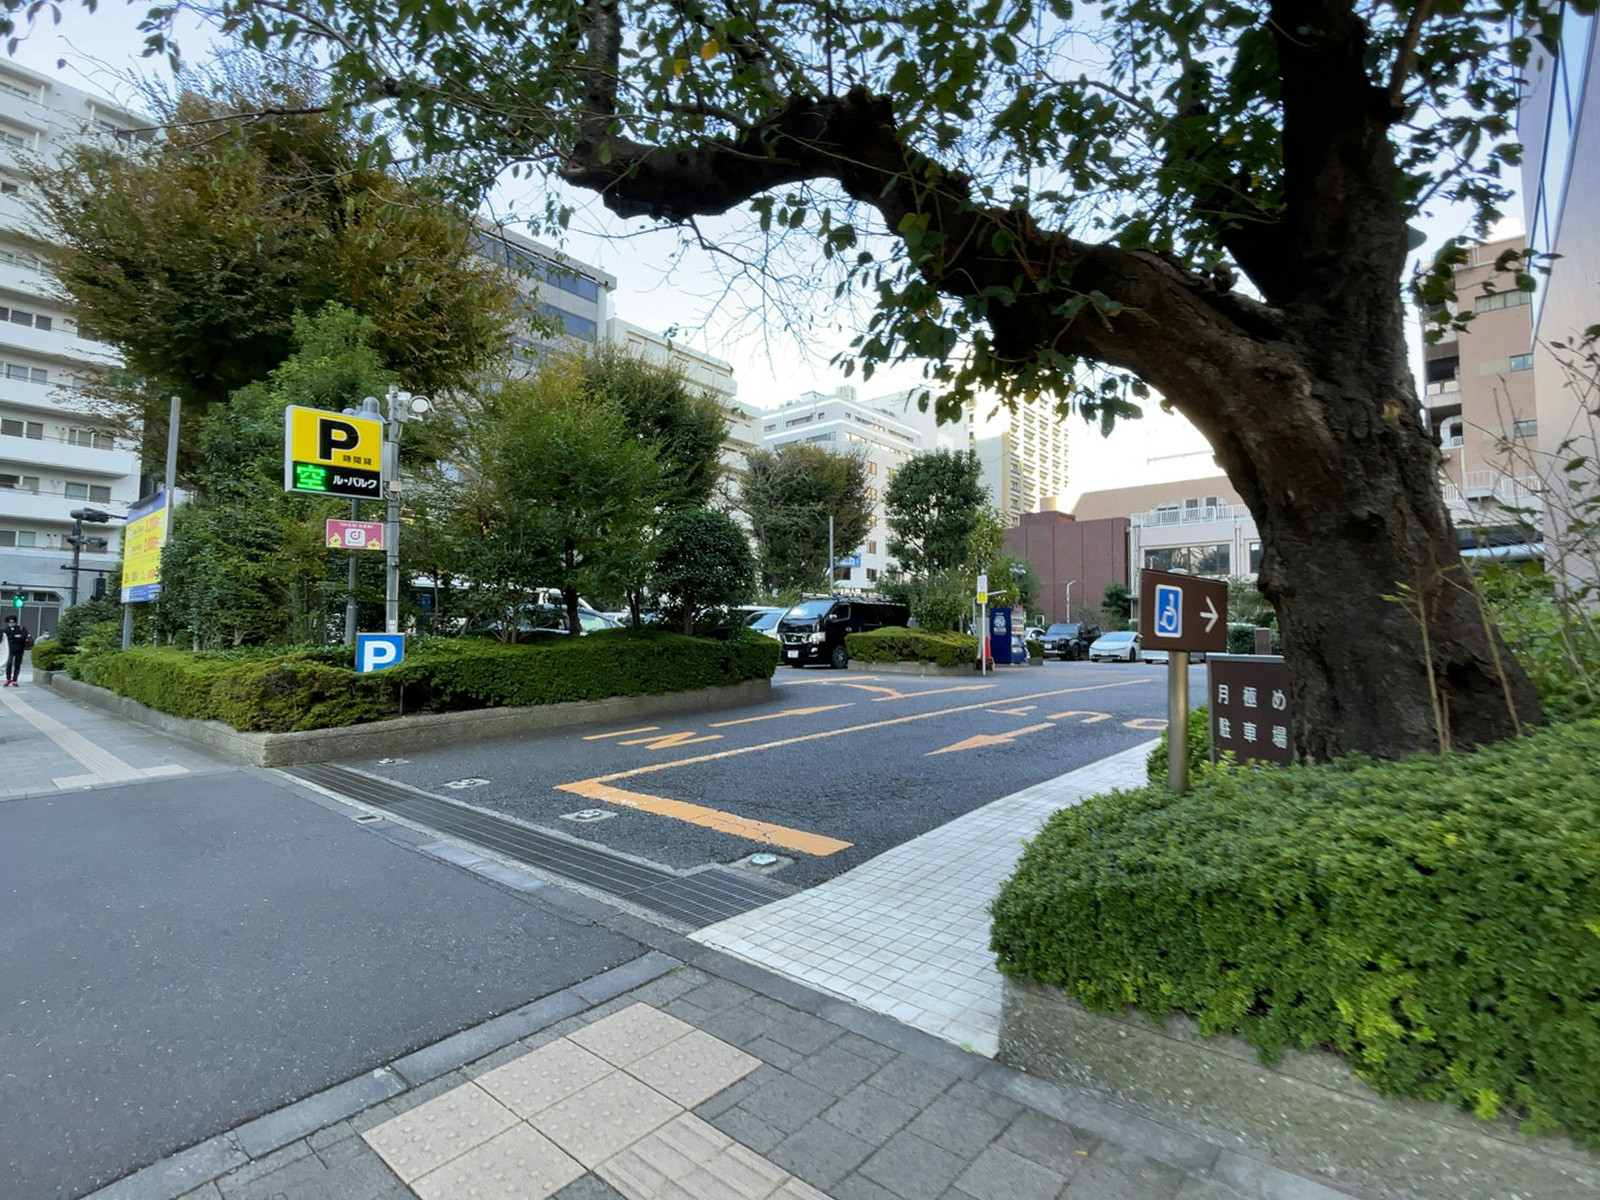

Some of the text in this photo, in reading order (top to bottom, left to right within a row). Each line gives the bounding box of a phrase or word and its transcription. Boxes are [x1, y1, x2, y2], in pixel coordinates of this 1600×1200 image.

[319, 418, 359, 460] P
[342, 454, 372, 466] 時間貸
[296, 464, 326, 490] 空
[363, 640, 396, 672] P
[1217, 684, 1287, 711] 月極め
[1218, 717, 1288, 749] 駐車場
